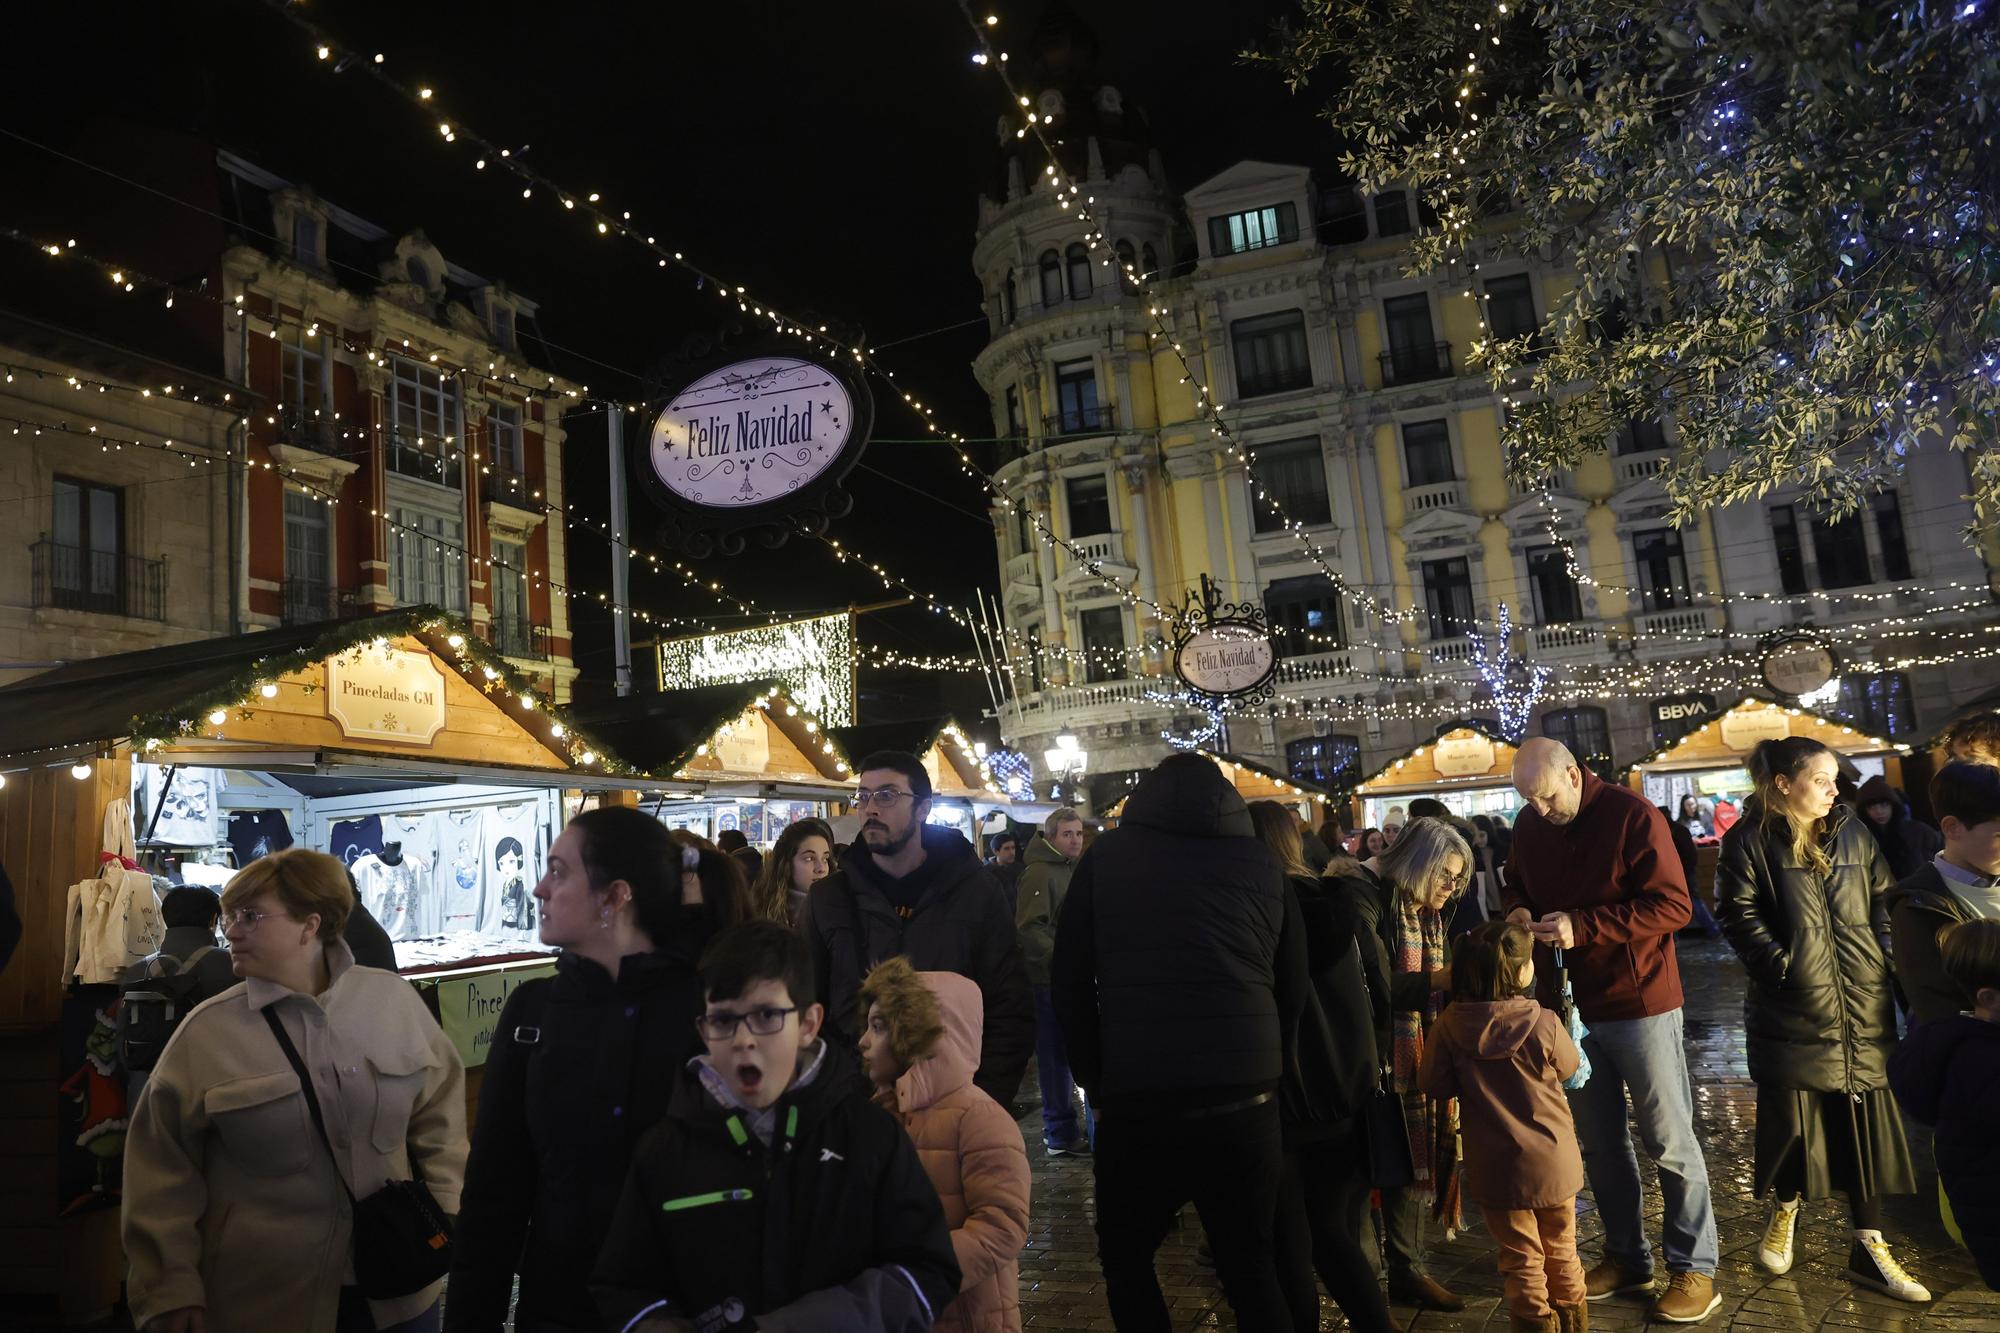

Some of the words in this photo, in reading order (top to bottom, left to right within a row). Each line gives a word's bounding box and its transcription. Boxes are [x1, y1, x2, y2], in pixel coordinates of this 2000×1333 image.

[687, 416, 730, 460] Feliz
[736, 400, 813, 453] Navidad
[1196, 651, 1218, 671] Feliz
[1219, 646, 1255, 667] Navidad
[342, 679, 410, 702] Pinceladas
[413, 690, 433, 705] GM
[1658, 701, 1708, 720] BBVA
